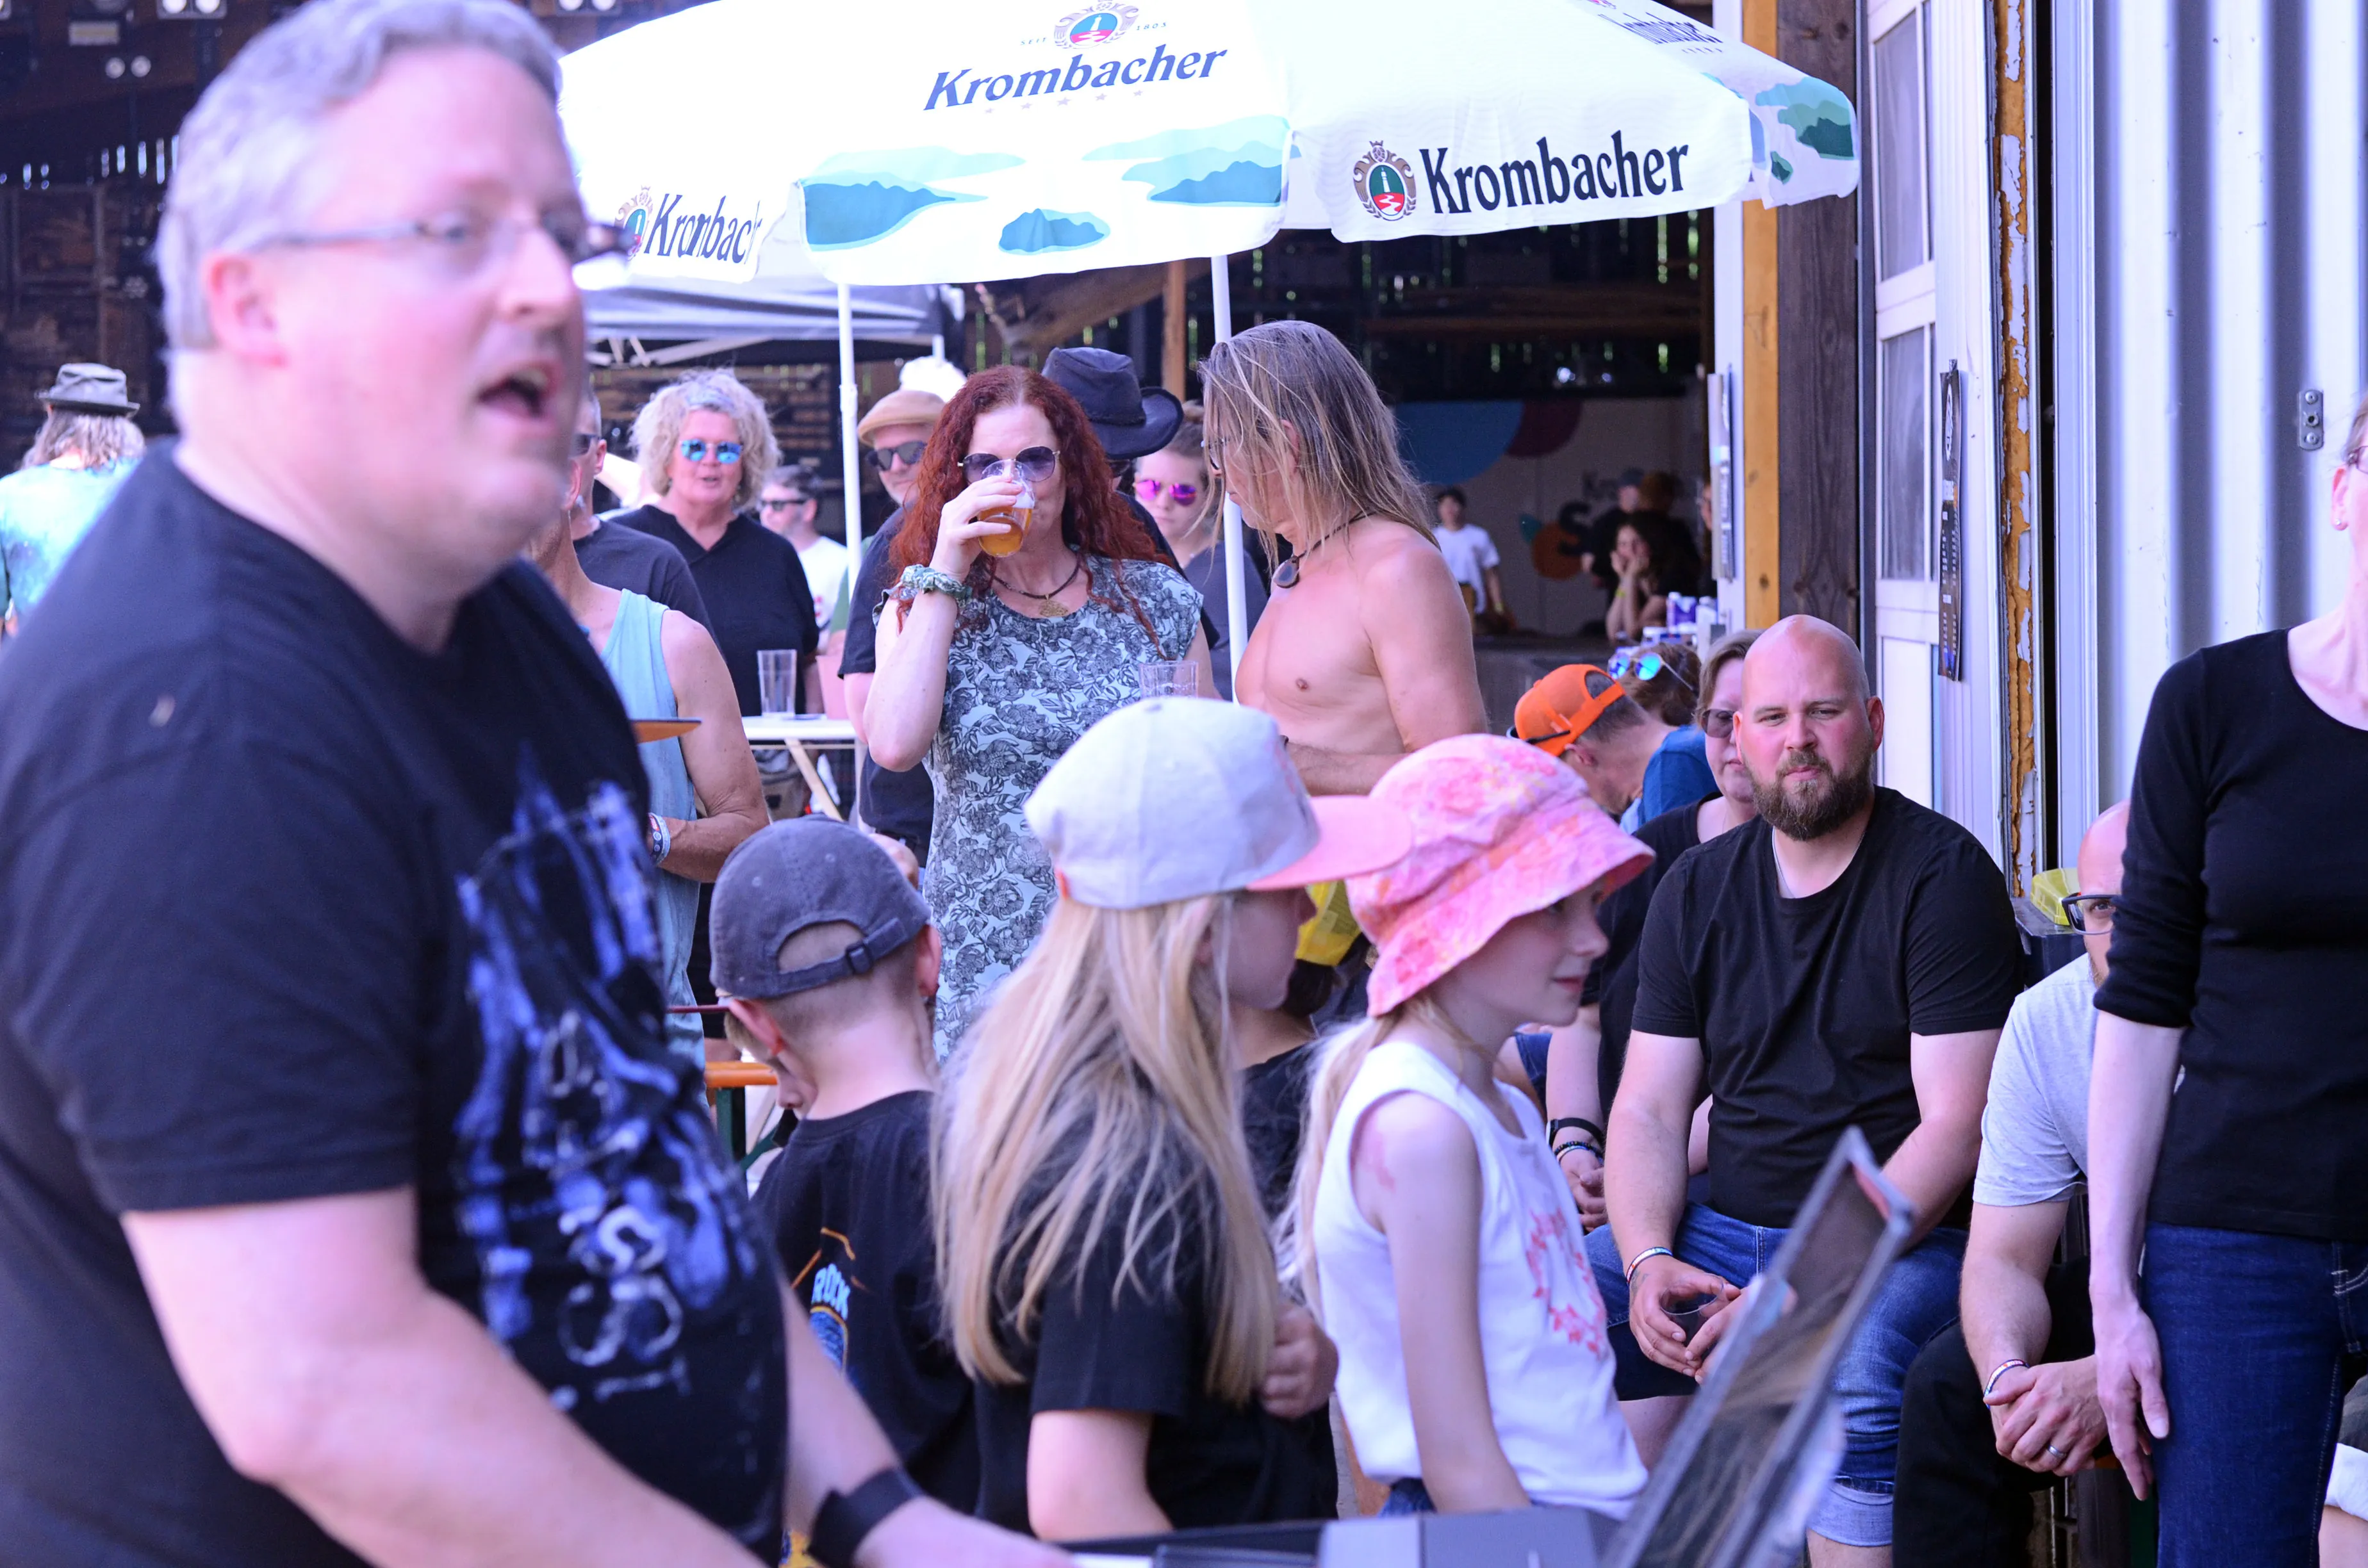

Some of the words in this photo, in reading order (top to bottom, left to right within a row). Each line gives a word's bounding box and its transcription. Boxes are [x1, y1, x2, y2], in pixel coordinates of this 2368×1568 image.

[1020, 37, 1046, 45] SEIT
[1136, 22, 1167, 31] 1803
[923, 44, 1228, 110] Krombacher
[1418, 130, 1689, 213] Krombacher
